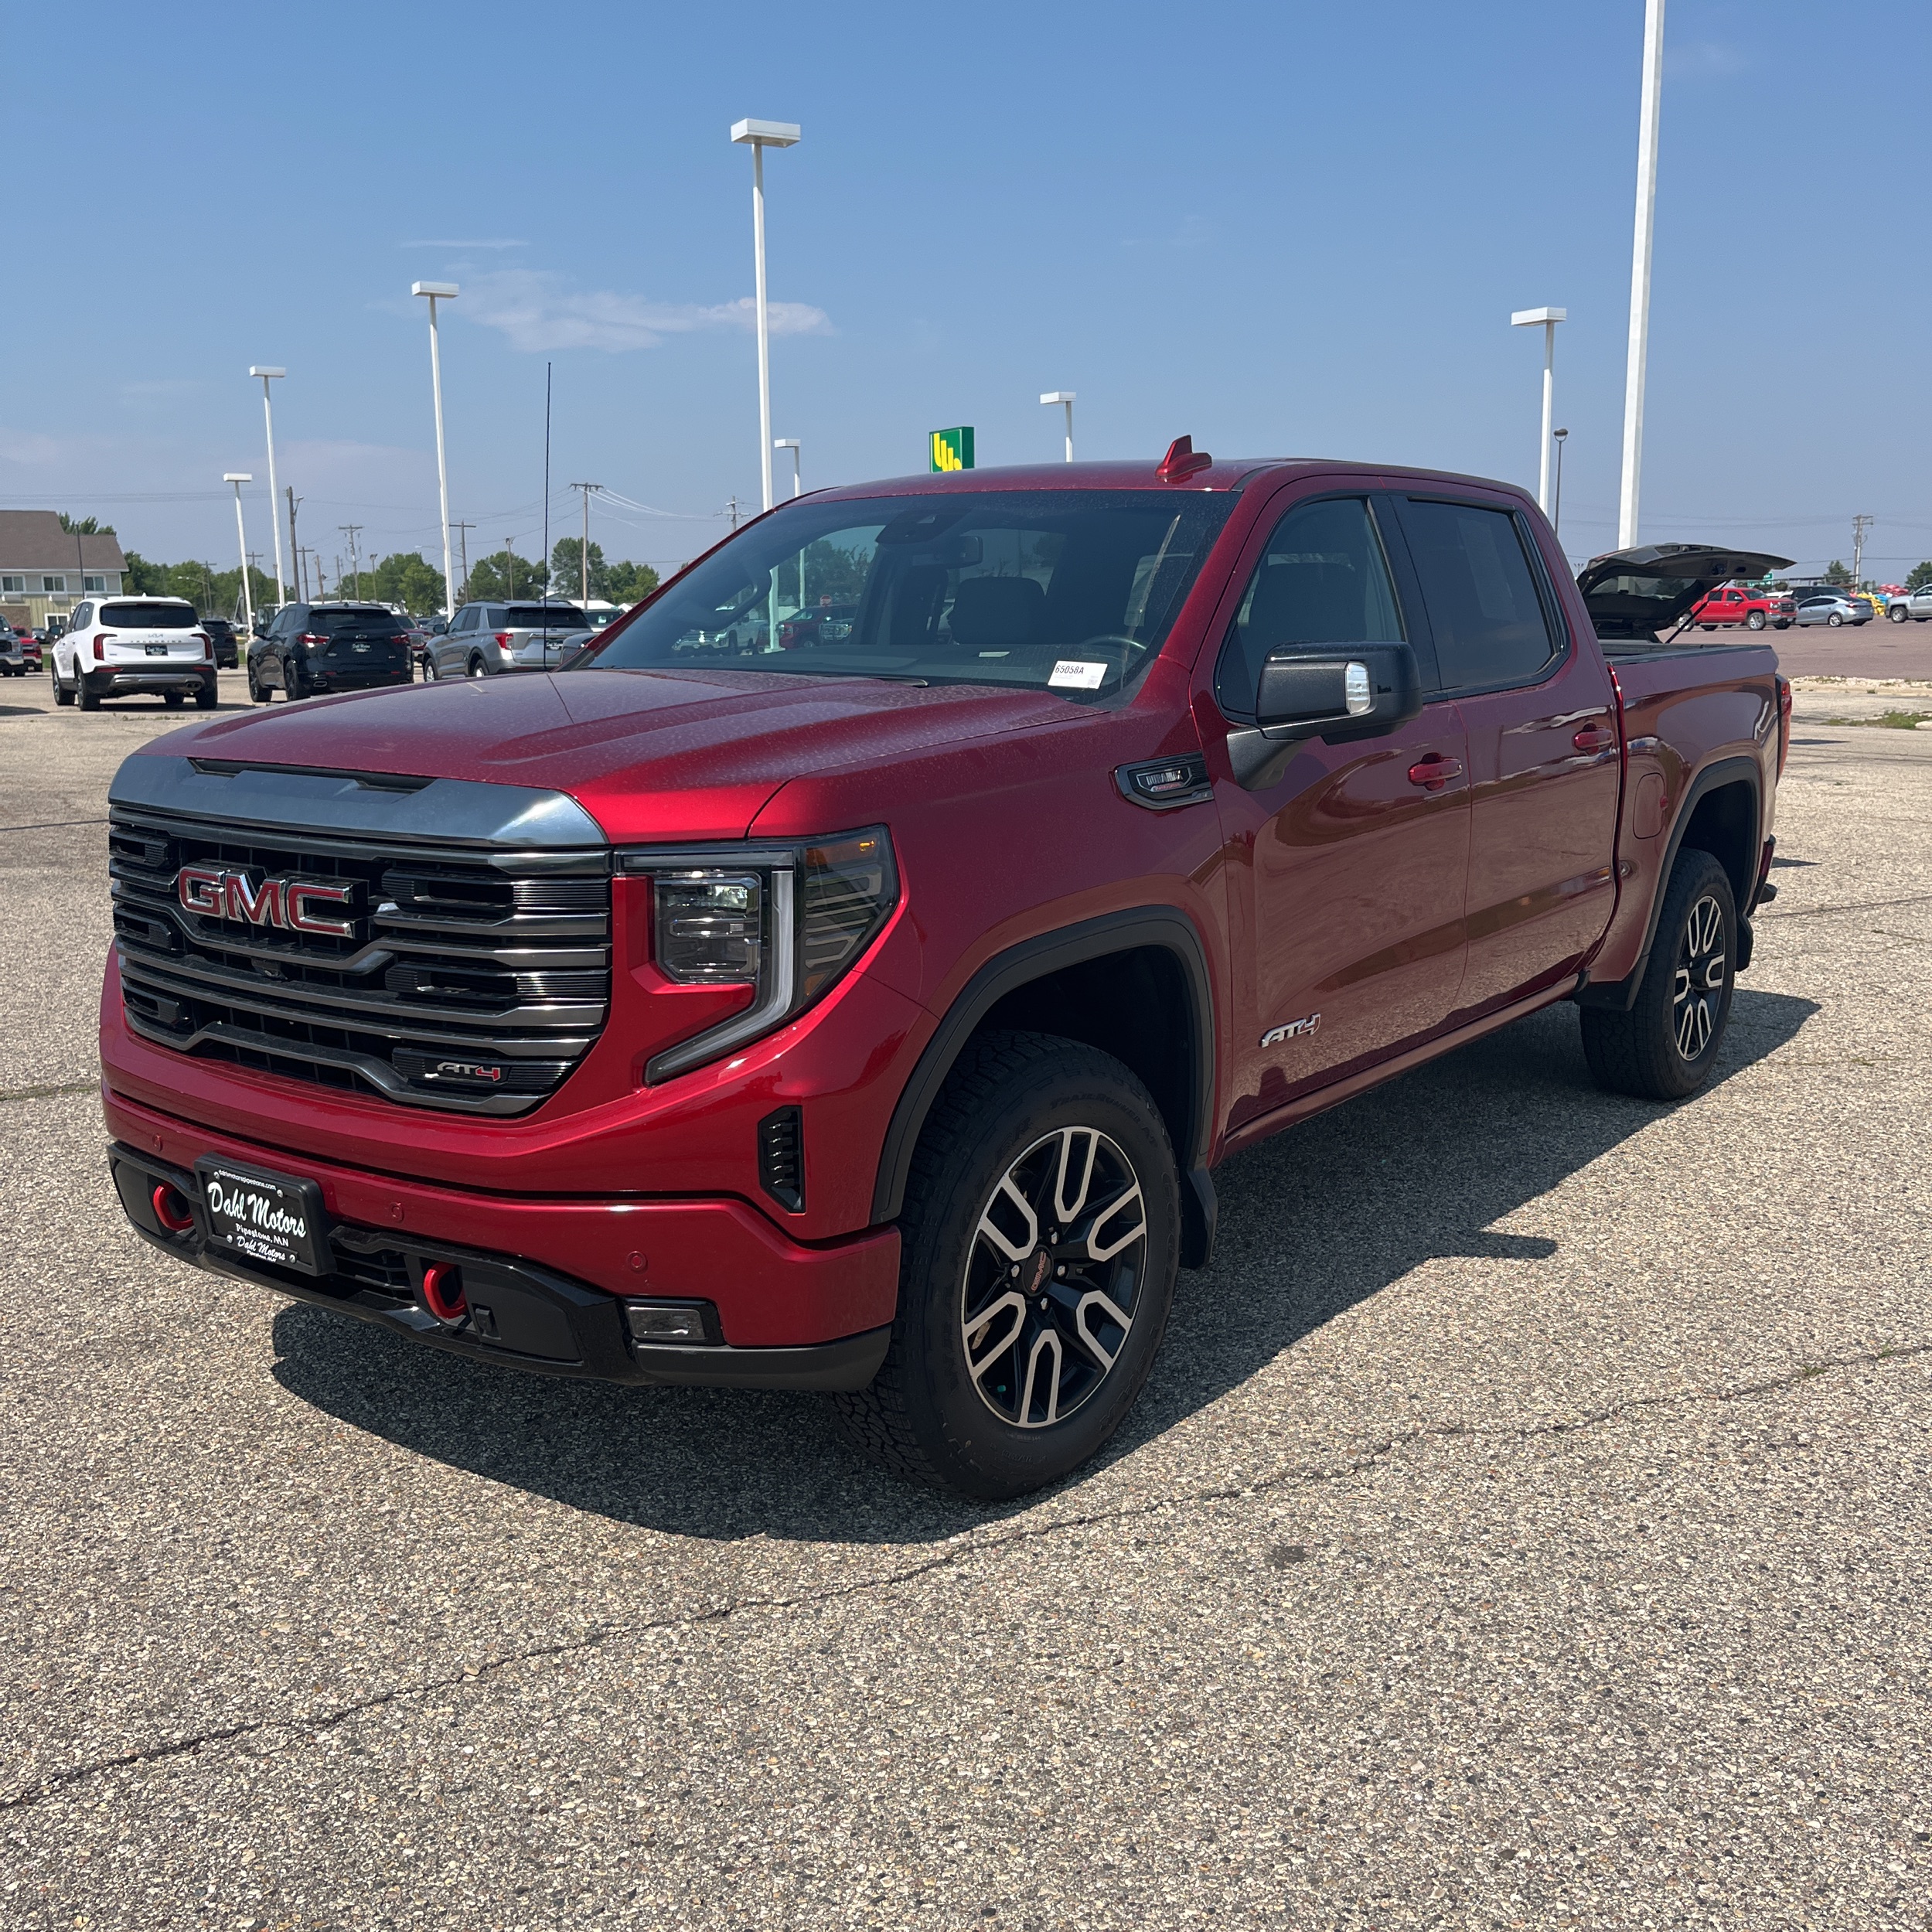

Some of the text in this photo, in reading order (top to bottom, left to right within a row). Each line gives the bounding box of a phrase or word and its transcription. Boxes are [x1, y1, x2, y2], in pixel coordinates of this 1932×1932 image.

[1055, 665, 1085, 675] 65058A
[1146, 770, 1183, 785] DURAMAX
[179, 862, 357, 940] GMC
[1260, 1013, 1321, 1048] AT4
[436, 1061, 501, 1082] AT4
[207, 1181, 307, 1238] Dahl Motors
[237, 1235, 286, 1261] Dahl Motors
[273, 1234, 289, 1247] MN
[1031, 1251, 1047, 1291] GMC
